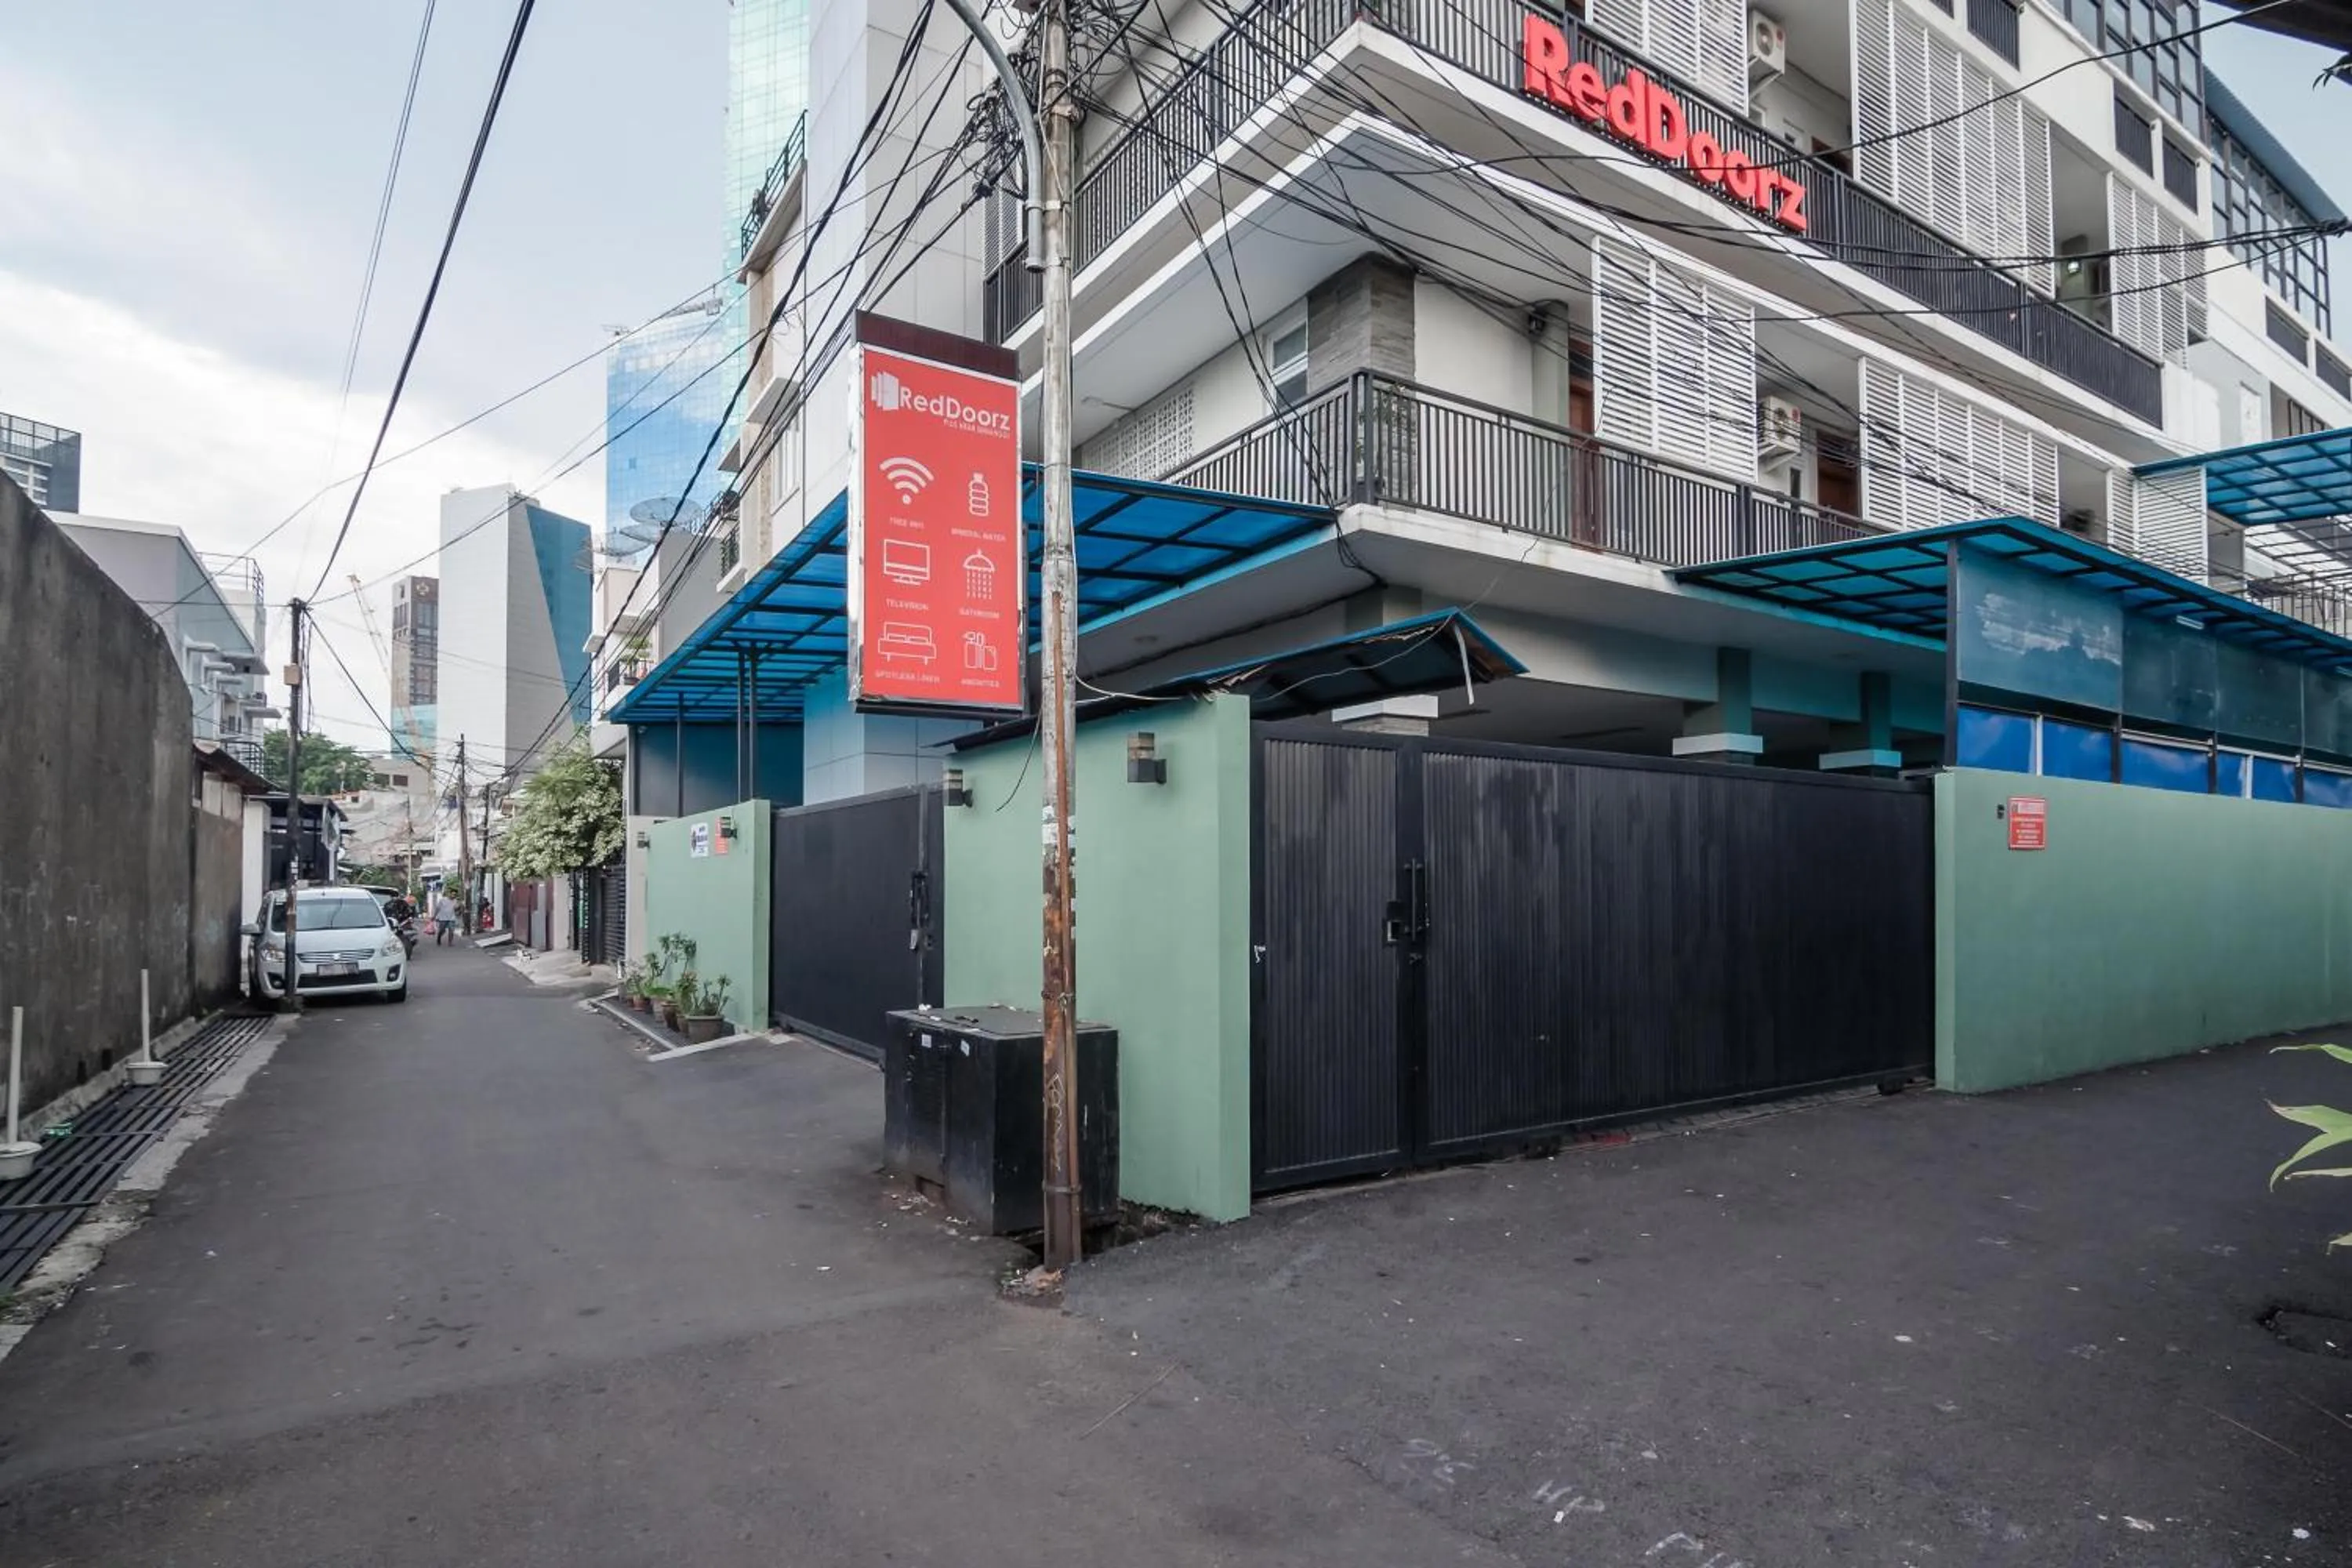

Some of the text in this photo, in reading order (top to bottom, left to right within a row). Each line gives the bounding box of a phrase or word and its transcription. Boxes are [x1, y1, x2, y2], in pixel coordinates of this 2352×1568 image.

[1524, 13, 1806, 230] RedDoorz
[900, 387, 1011, 430] RedDoorz
[886, 597, 929, 611] TELEVISION
